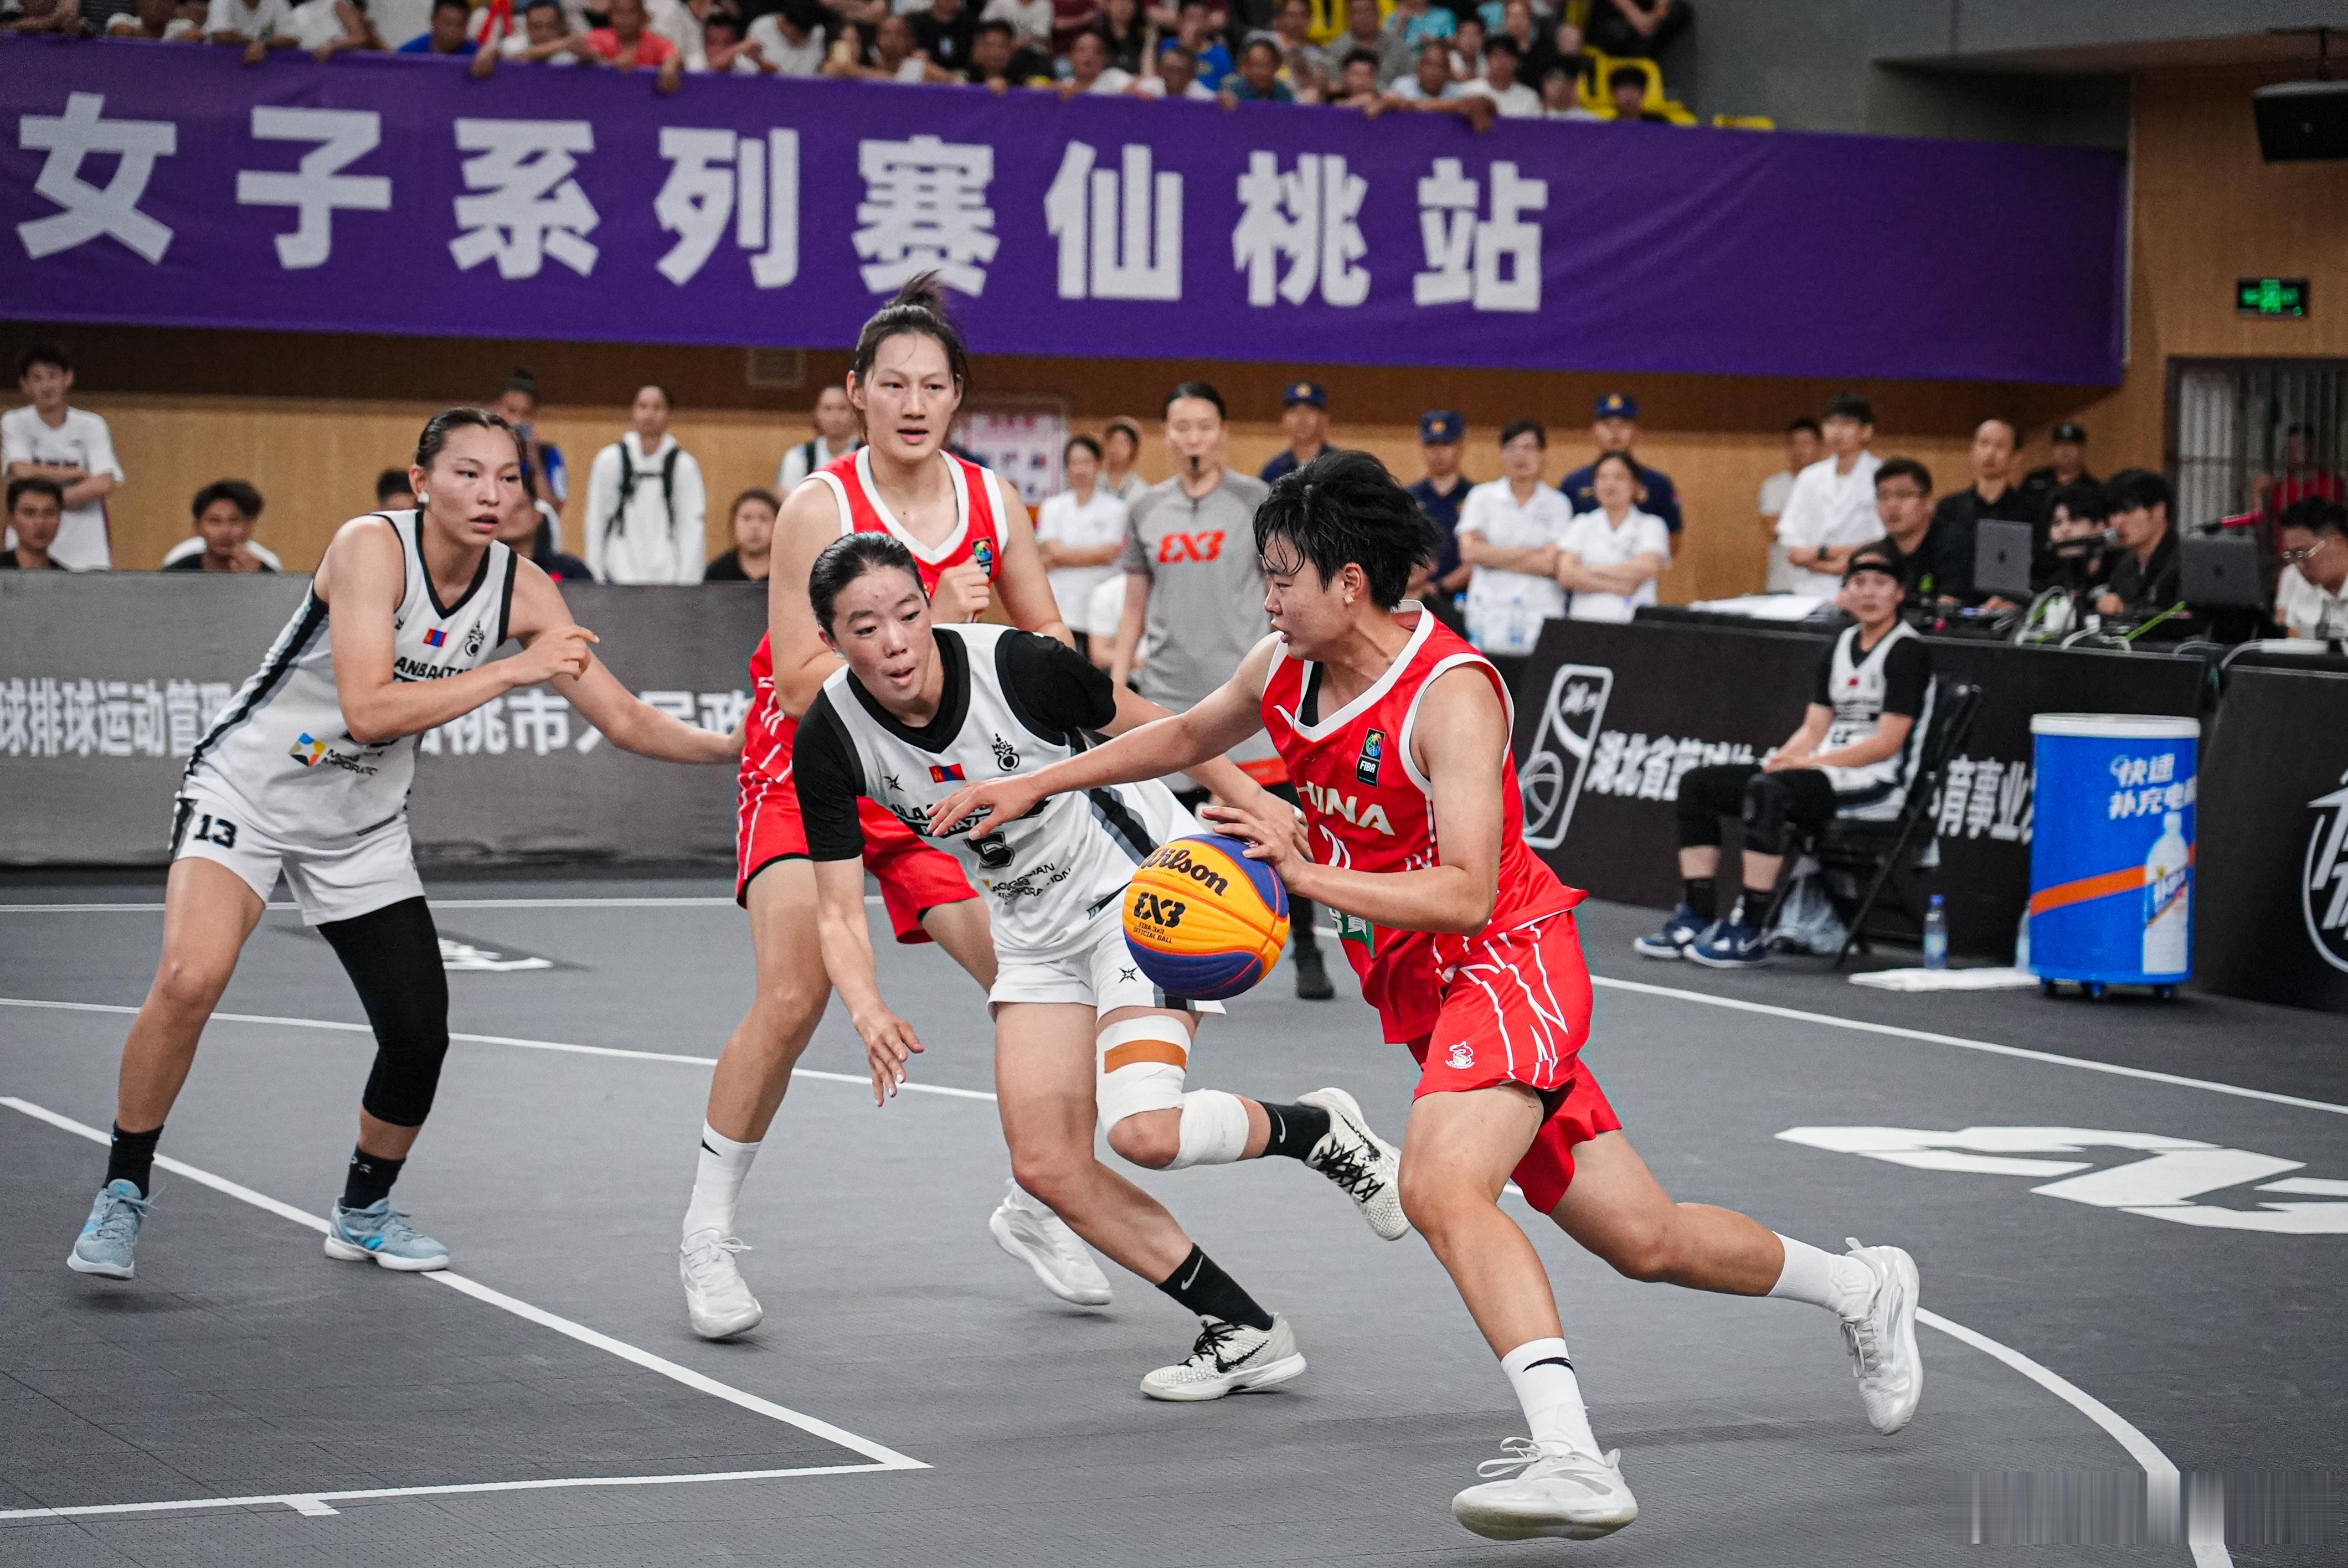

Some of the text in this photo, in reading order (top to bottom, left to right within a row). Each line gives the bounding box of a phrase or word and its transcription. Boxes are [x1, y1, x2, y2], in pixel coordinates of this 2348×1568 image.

[17, 92, 1547, 312] 女子系列赛仙桃站
[991, 740, 1012, 753] MGL
[1359, 760, 1376, 773] FIBA
[193, 813, 238, 849] 13
[962, 831, 1015, 869] 5
[1141, 848, 1228, 897] Wilson
[1133, 927, 1172, 944] OFFICIAL BALL
[1139, 922, 1151, 930] FIBA
